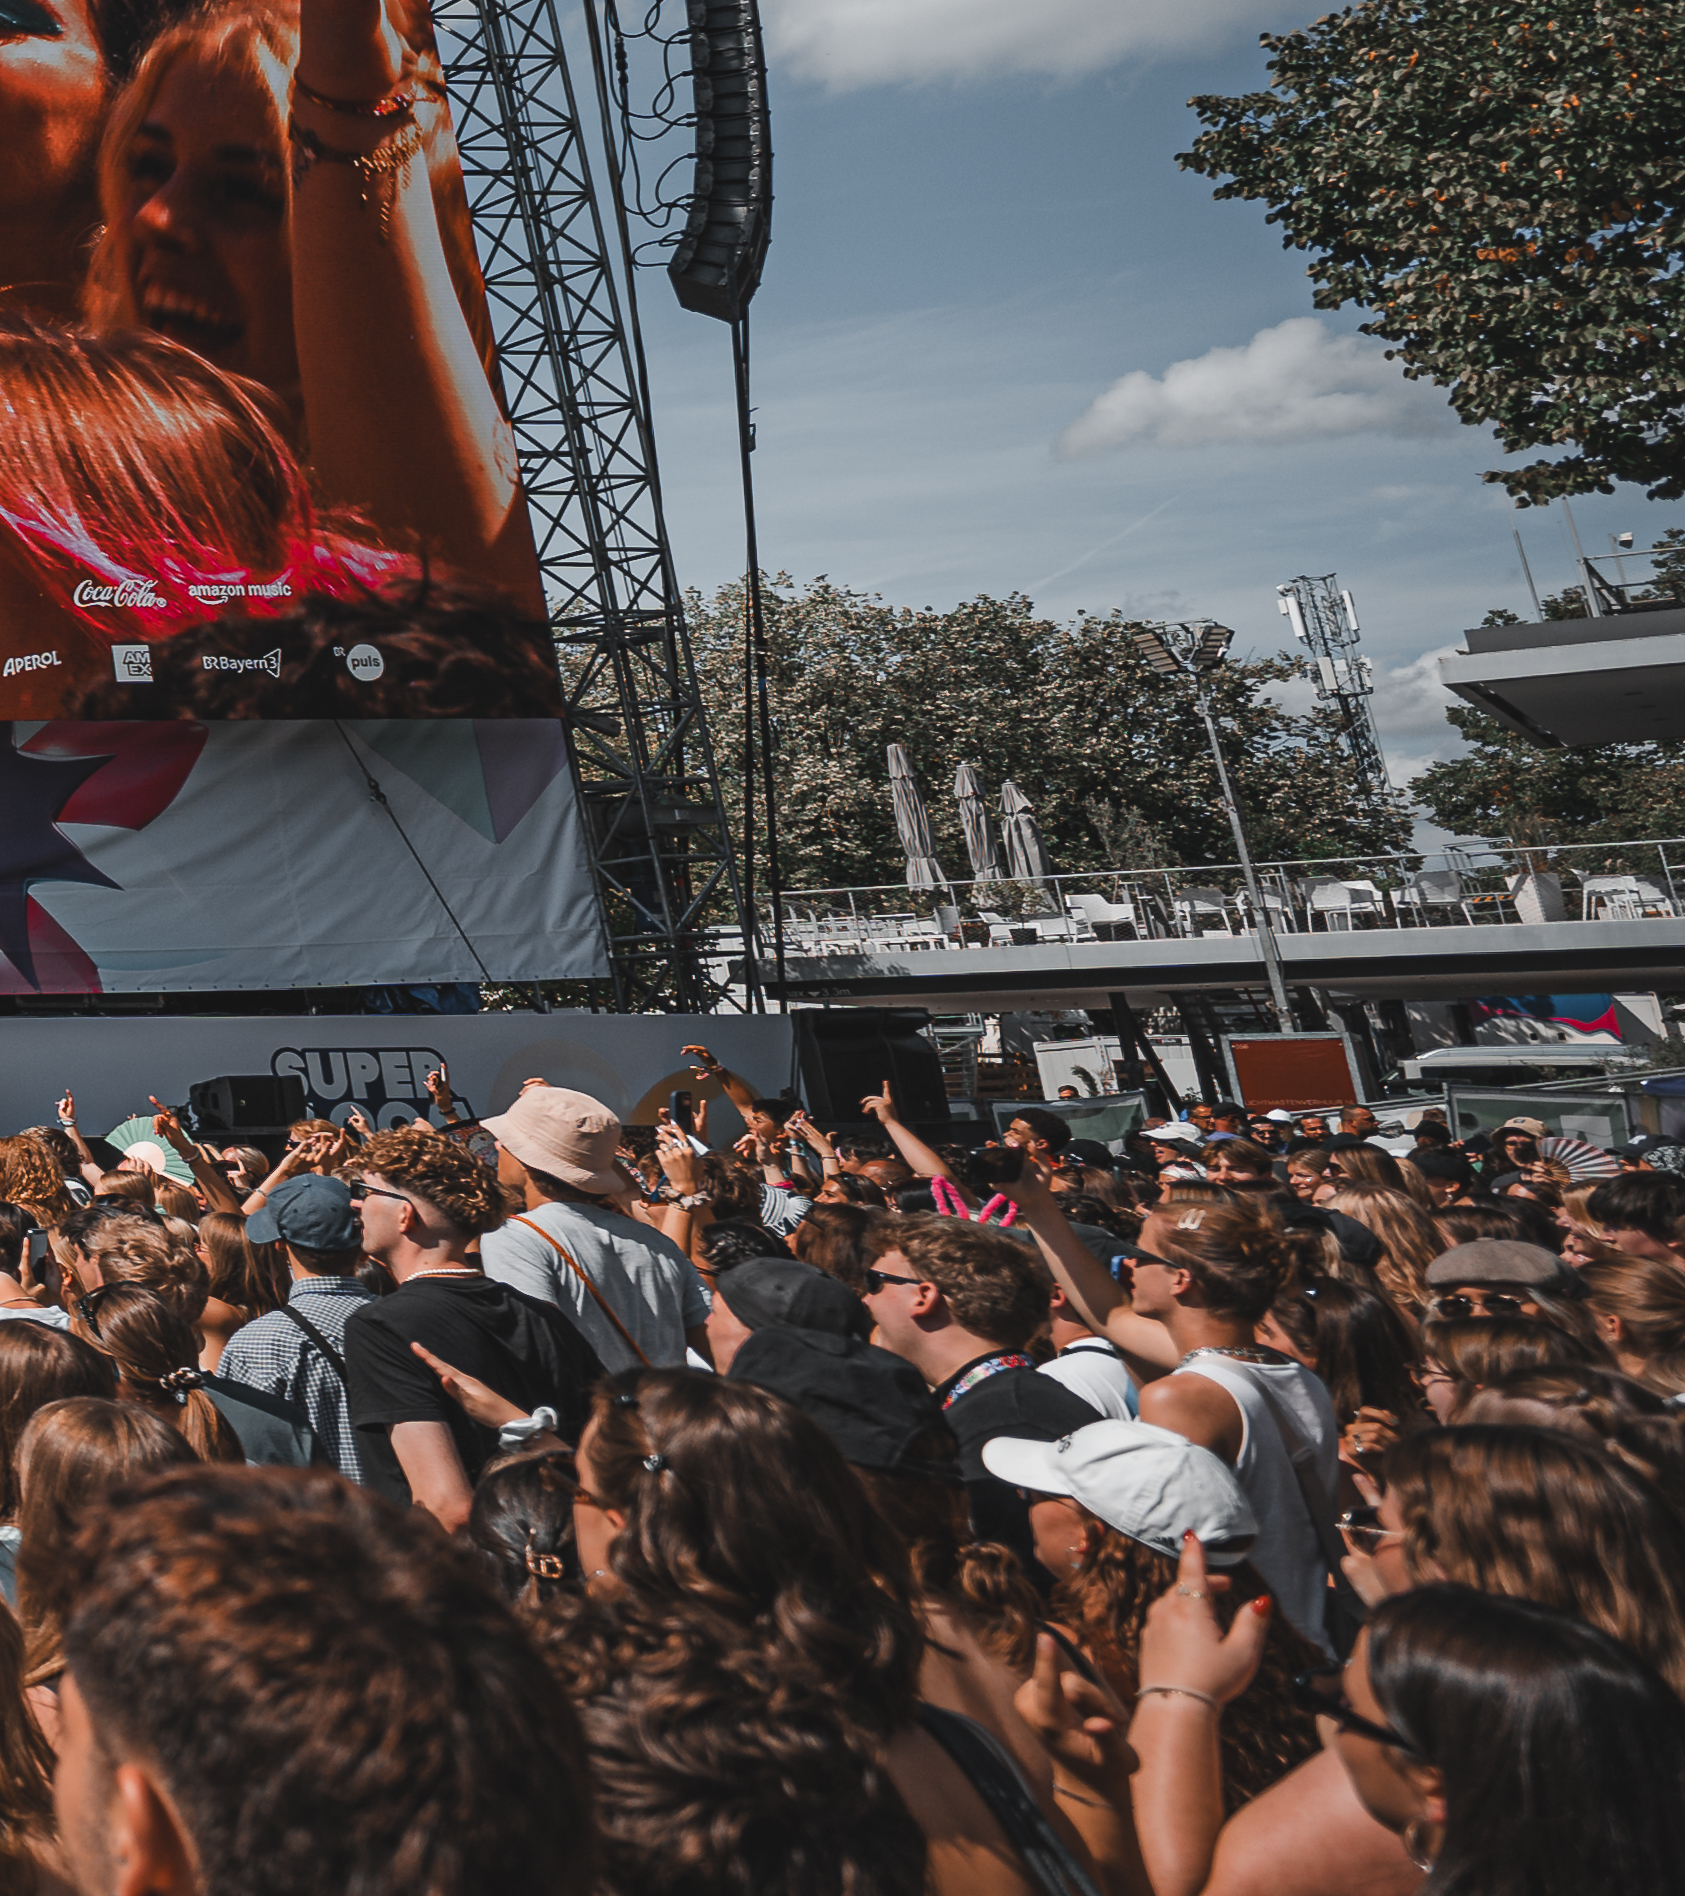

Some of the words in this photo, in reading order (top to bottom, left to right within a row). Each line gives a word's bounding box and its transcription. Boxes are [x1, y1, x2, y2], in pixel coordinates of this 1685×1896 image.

[73, 579, 160, 607] Coca-Cola
[188, 584, 245, 597] amazon
[247, 582, 292, 597] music
[2, 651, 62, 678] APEROL
[350, 655, 381, 671] puls
